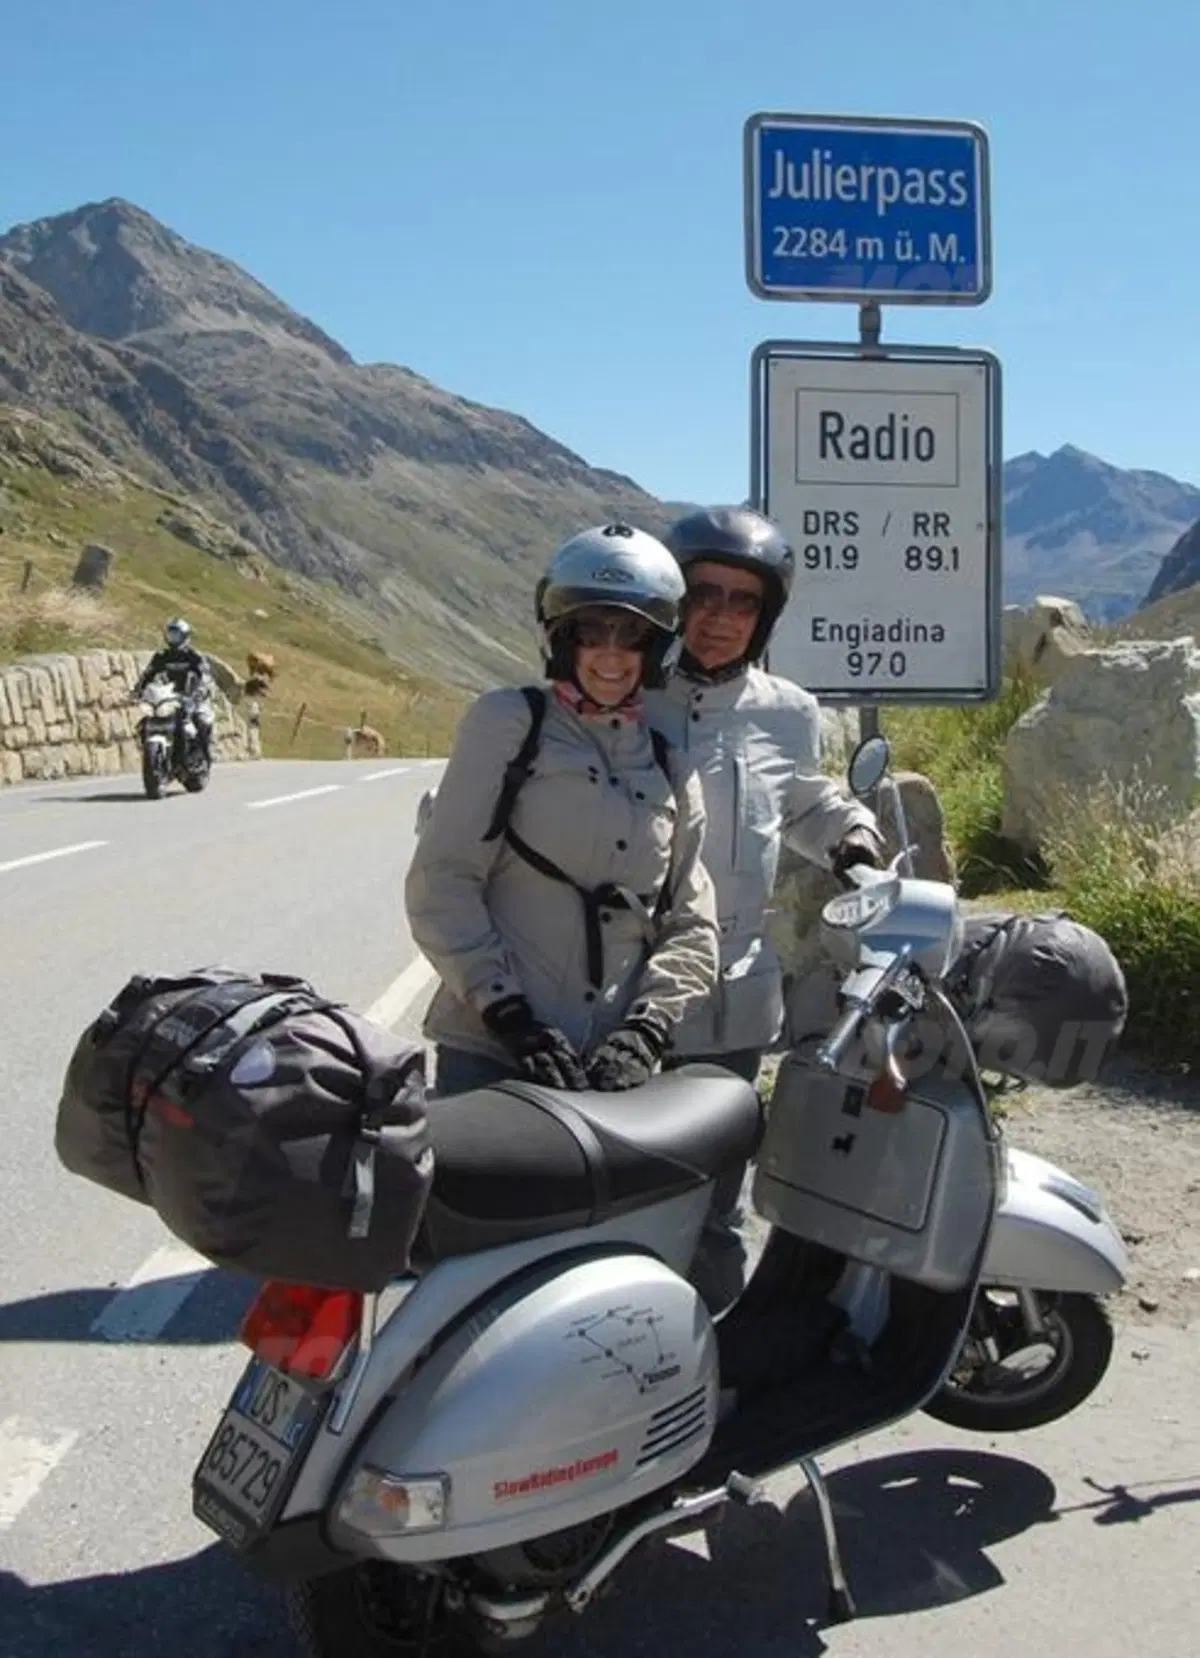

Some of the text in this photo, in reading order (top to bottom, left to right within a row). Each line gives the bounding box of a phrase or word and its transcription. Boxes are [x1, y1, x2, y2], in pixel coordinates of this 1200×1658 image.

[768, 149, 969, 217] Julierpass
[772, 225, 967, 264] 2284 m ü. M.
[818, 410, 936, 462] Radio
[803, 510, 860, 537] DRS
[912, 513, 951, 538] RR
[803, 544, 960, 572] 91.9 89.1
[811, 617, 946, 650] Engiadina
[207, 1424, 282, 1508] 85729
